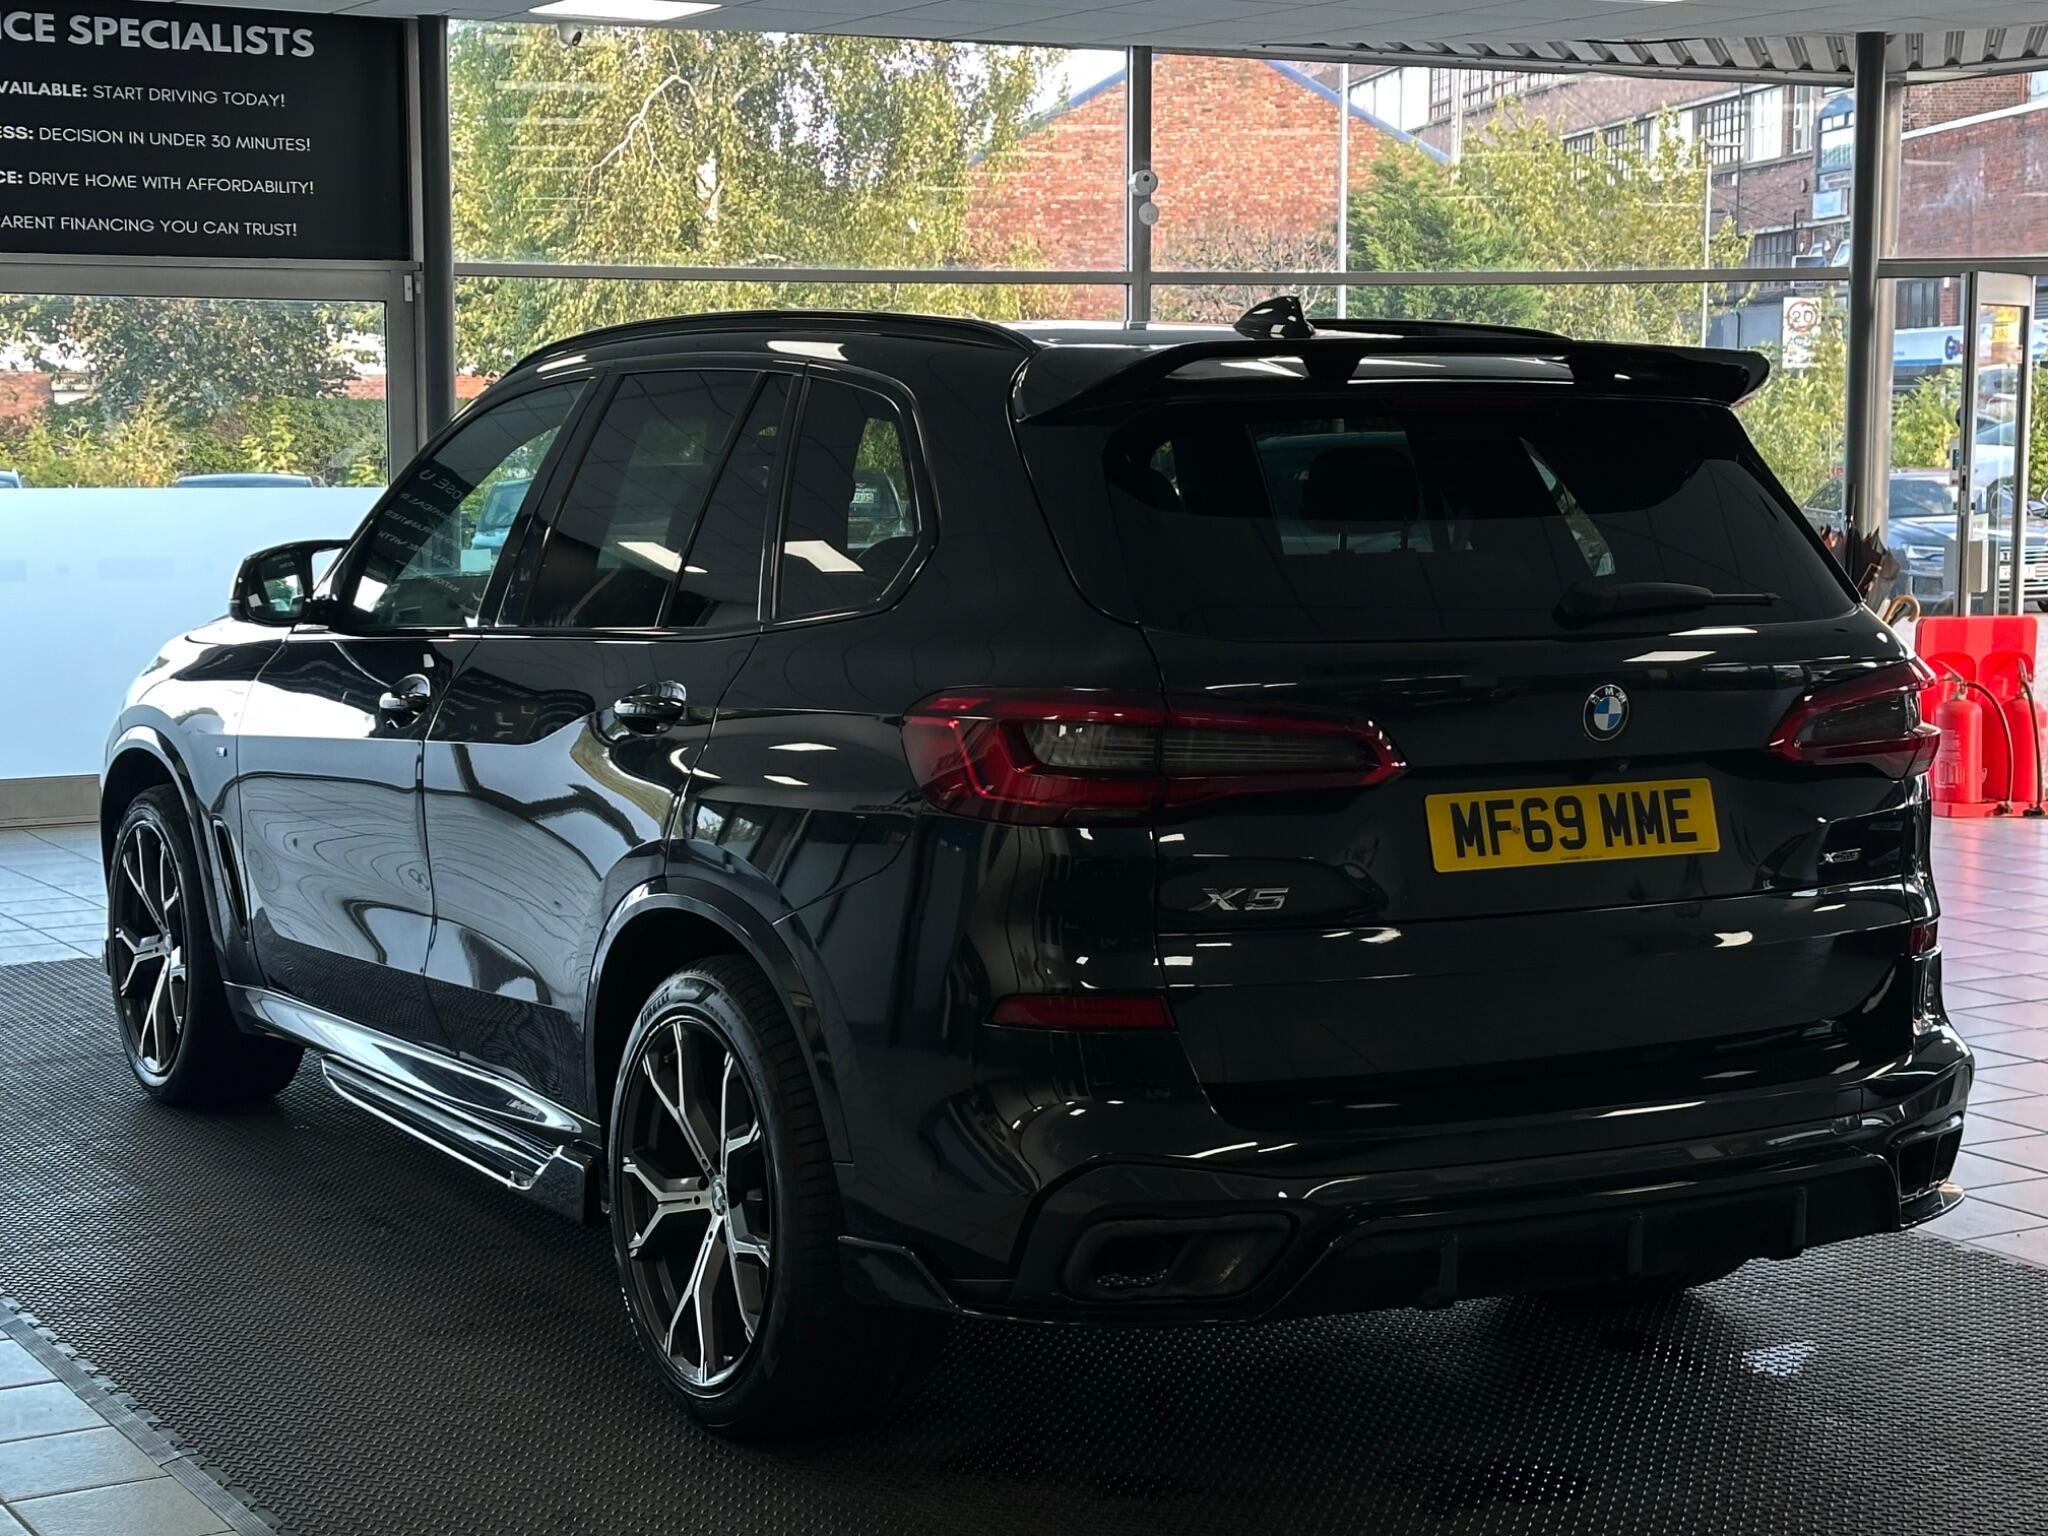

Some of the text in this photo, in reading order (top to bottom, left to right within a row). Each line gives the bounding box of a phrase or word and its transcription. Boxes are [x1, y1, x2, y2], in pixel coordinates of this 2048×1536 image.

[0, 11, 315, 57] CE SPECIALISTS
[92, 85, 144, 100] START
[148, 88, 218, 104] DRIVING
[222, 91, 285, 107] TODAY!
[0, 125, 311, 152] SS: DECISION IN UNDER 30 MINUTES!
[28, 171, 80, 187] DRIVE
[85, 173, 137, 188] HOME
[142, 175, 181, 190] WITH
[186, 177, 314, 195] AFFORDABILITY!
[60, 216, 155, 233] FINANCING
[159, 219, 198, 234] YOU
[203, 221, 239, 235] CAN
[243, 222, 297, 237] TRUST!
[1792, 310, 1814, 323] 20
[1589, 687, 1627, 704] BMW
[1450, 788, 1699, 859] MF69 MME
[1188, 887, 1289, 911] X5
[639, 985, 671, 1028] PIRELLI
